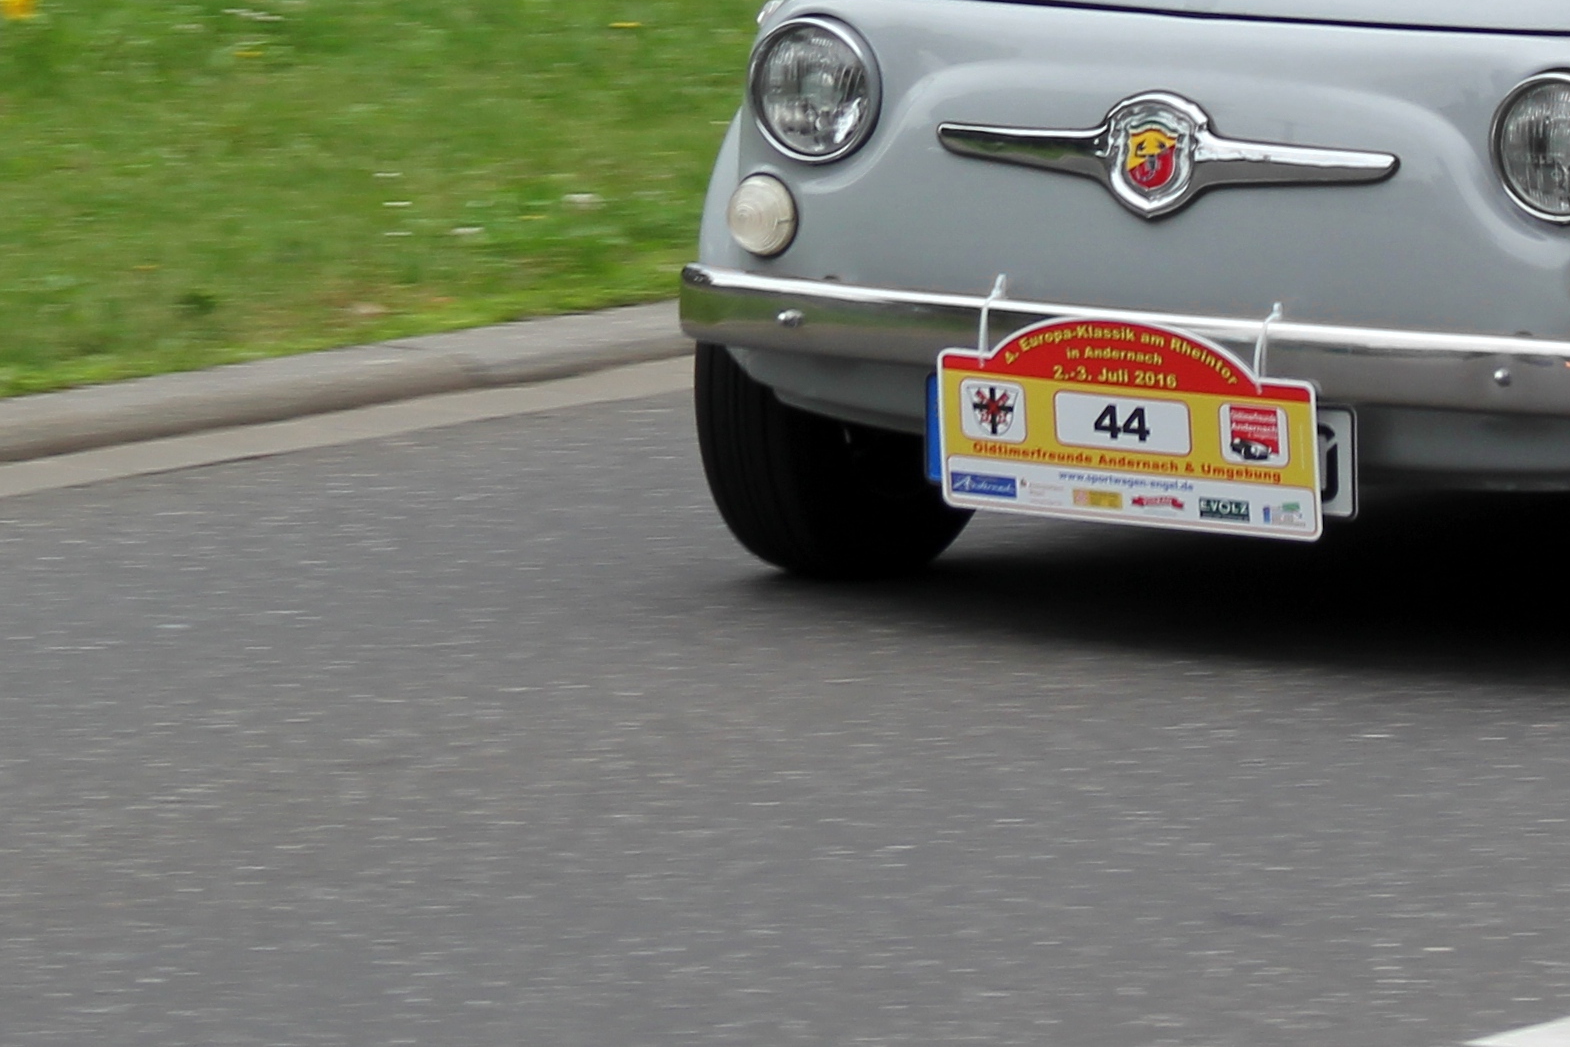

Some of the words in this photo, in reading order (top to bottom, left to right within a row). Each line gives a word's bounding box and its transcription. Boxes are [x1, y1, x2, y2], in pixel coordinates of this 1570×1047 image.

[1018, 324, 1136, 353] Europa-Klassik
[1140, 332, 1165, 348] am
[1169, 336, 1239, 385] Rheintor
[1066, 346, 1080, 360] in
[1084, 346, 1163, 366] Andernach
[1097, 367, 1129, 384] Juli
[1134, 369, 1178, 390] 2016
[1094, 403, 1151, 443] 44
[972, 441, 1094, 465] Oldtimerfreunde
[1098, 453, 1178, 473] Andernach
[1184, 460, 1196, 473] &
[1200, 462, 1282, 485] Umgebung
